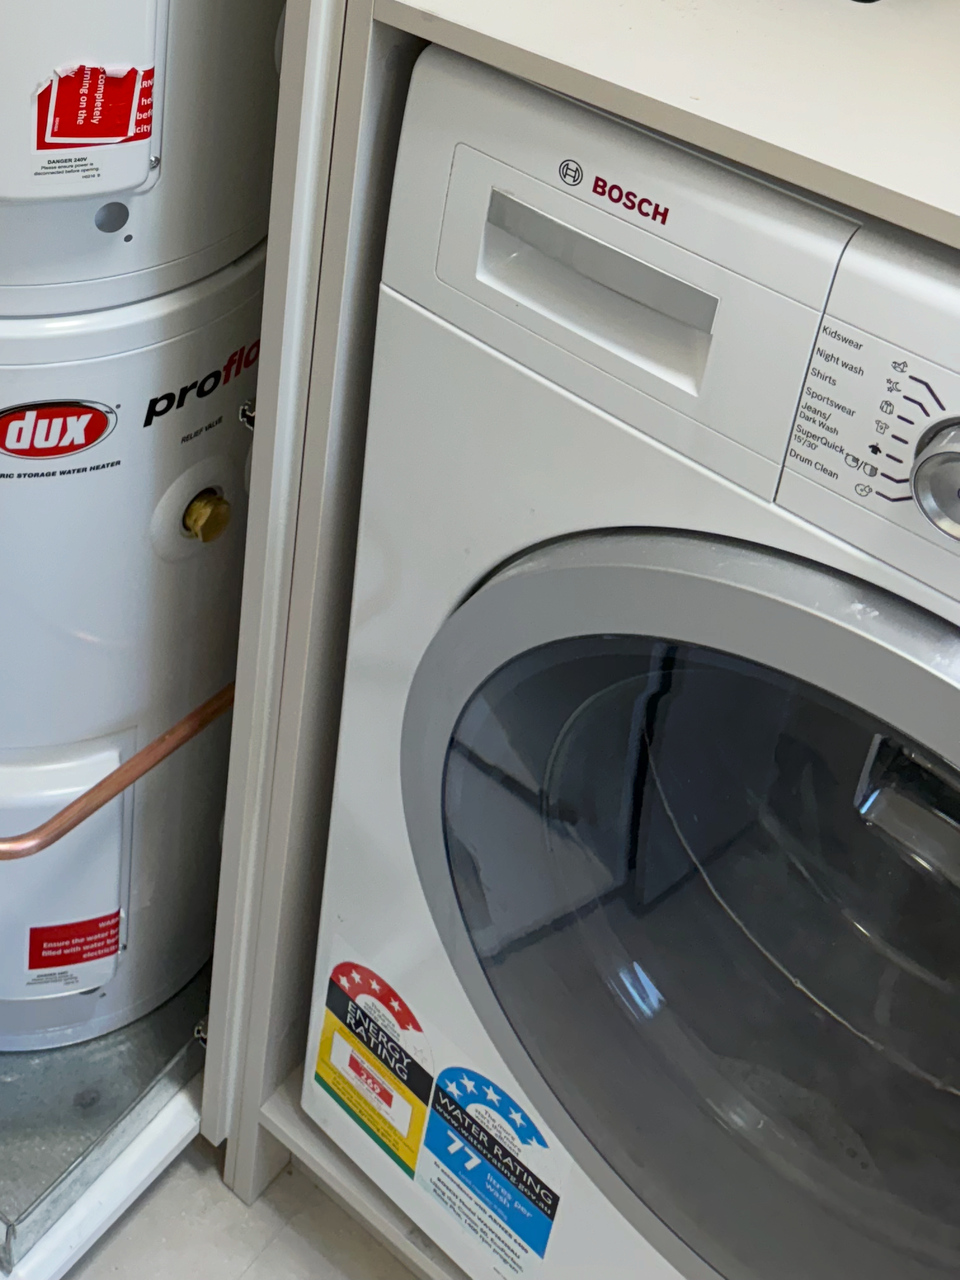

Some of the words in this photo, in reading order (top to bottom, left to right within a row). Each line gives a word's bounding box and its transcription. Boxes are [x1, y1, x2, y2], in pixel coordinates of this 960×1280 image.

[80, 96, 87, 108] on
[91, 74, 106, 124] completely
[77, 109, 87, 125] the
[592, 176, 669, 225] BOSCH
[822, 325, 863, 351] Kidswear
[816, 347, 839, 365] Night
[841, 361, 864, 376] wash
[811, 368, 837, 386] Shirts
[802, 402, 832, 421] Jeans/
[805, 387, 856, 417] Sportswear
[5, 410, 93, 450] dux
[181, 430, 203, 444] RELIEF
[205, 416, 223, 431] VALVE
[799, 411, 816, 425] Dark
[818, 420, 839, 436] Wash
[796, 424, 845, 455] SuperQuick
[17, 471, 57, 479] STORAGE
[59, 467, 87, 476] WATER
[90, 460, 121, 472] HEATER
[790, 449, 813, 467] Drum
[814, 463, 839, 480] Clean
[42, 949, 62, 957] filled
[63, 946, 81, 954] with
[83, 941, 105, 950] water
[43, 940, 70, 949] Ensure
[86, 932, 109, 941] water
[347, 1013, 408, 1080] RATING
[348, 1001, 411, 1066] ENERGY
[361, 1071, 381, 1094] 269
[436, 1103, 551, 1214] www.waterrating.gov.au
[439, 1092, 488, 1147] WATER
[494, 1145, 552, 1205] RATING
[447, 1129, 481, 1171] 77
[485, 1182, 510, 1208] wash
[487, 1173, 512, 1200] litres
[514, 1199, 532, 1218] per
